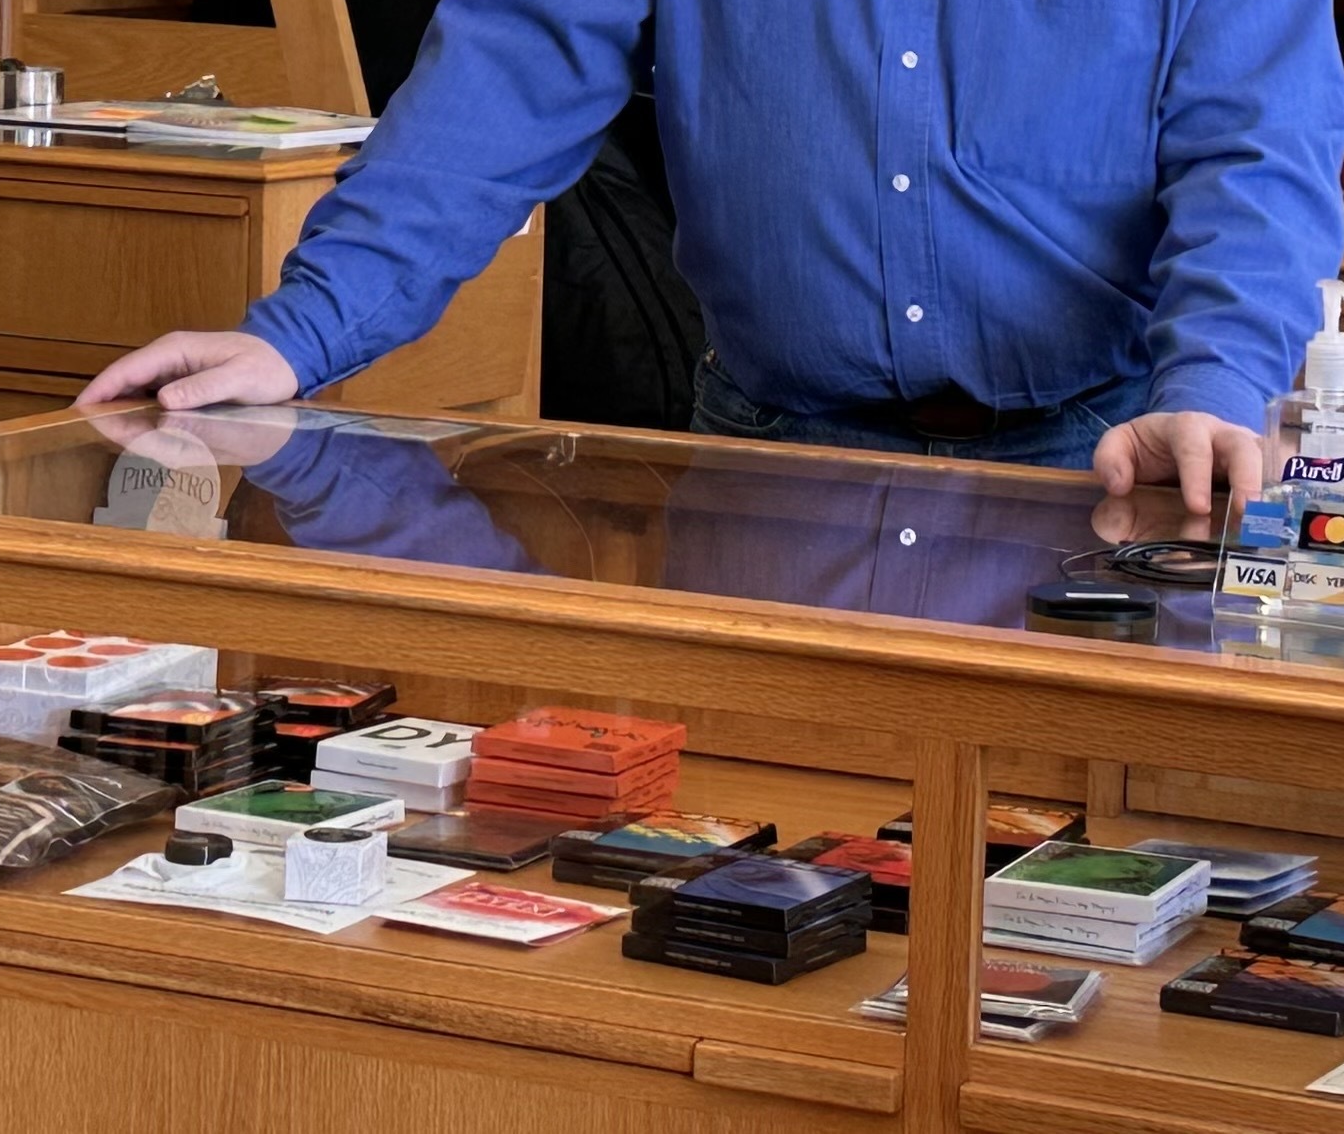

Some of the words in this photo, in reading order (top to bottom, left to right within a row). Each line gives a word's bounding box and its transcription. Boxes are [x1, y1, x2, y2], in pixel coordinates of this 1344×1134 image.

[1289, 457, 1344, 481] Purell
[120, 467, 214, 505] PIRASTRO
[1236, 566, 1277, 586] VISA
